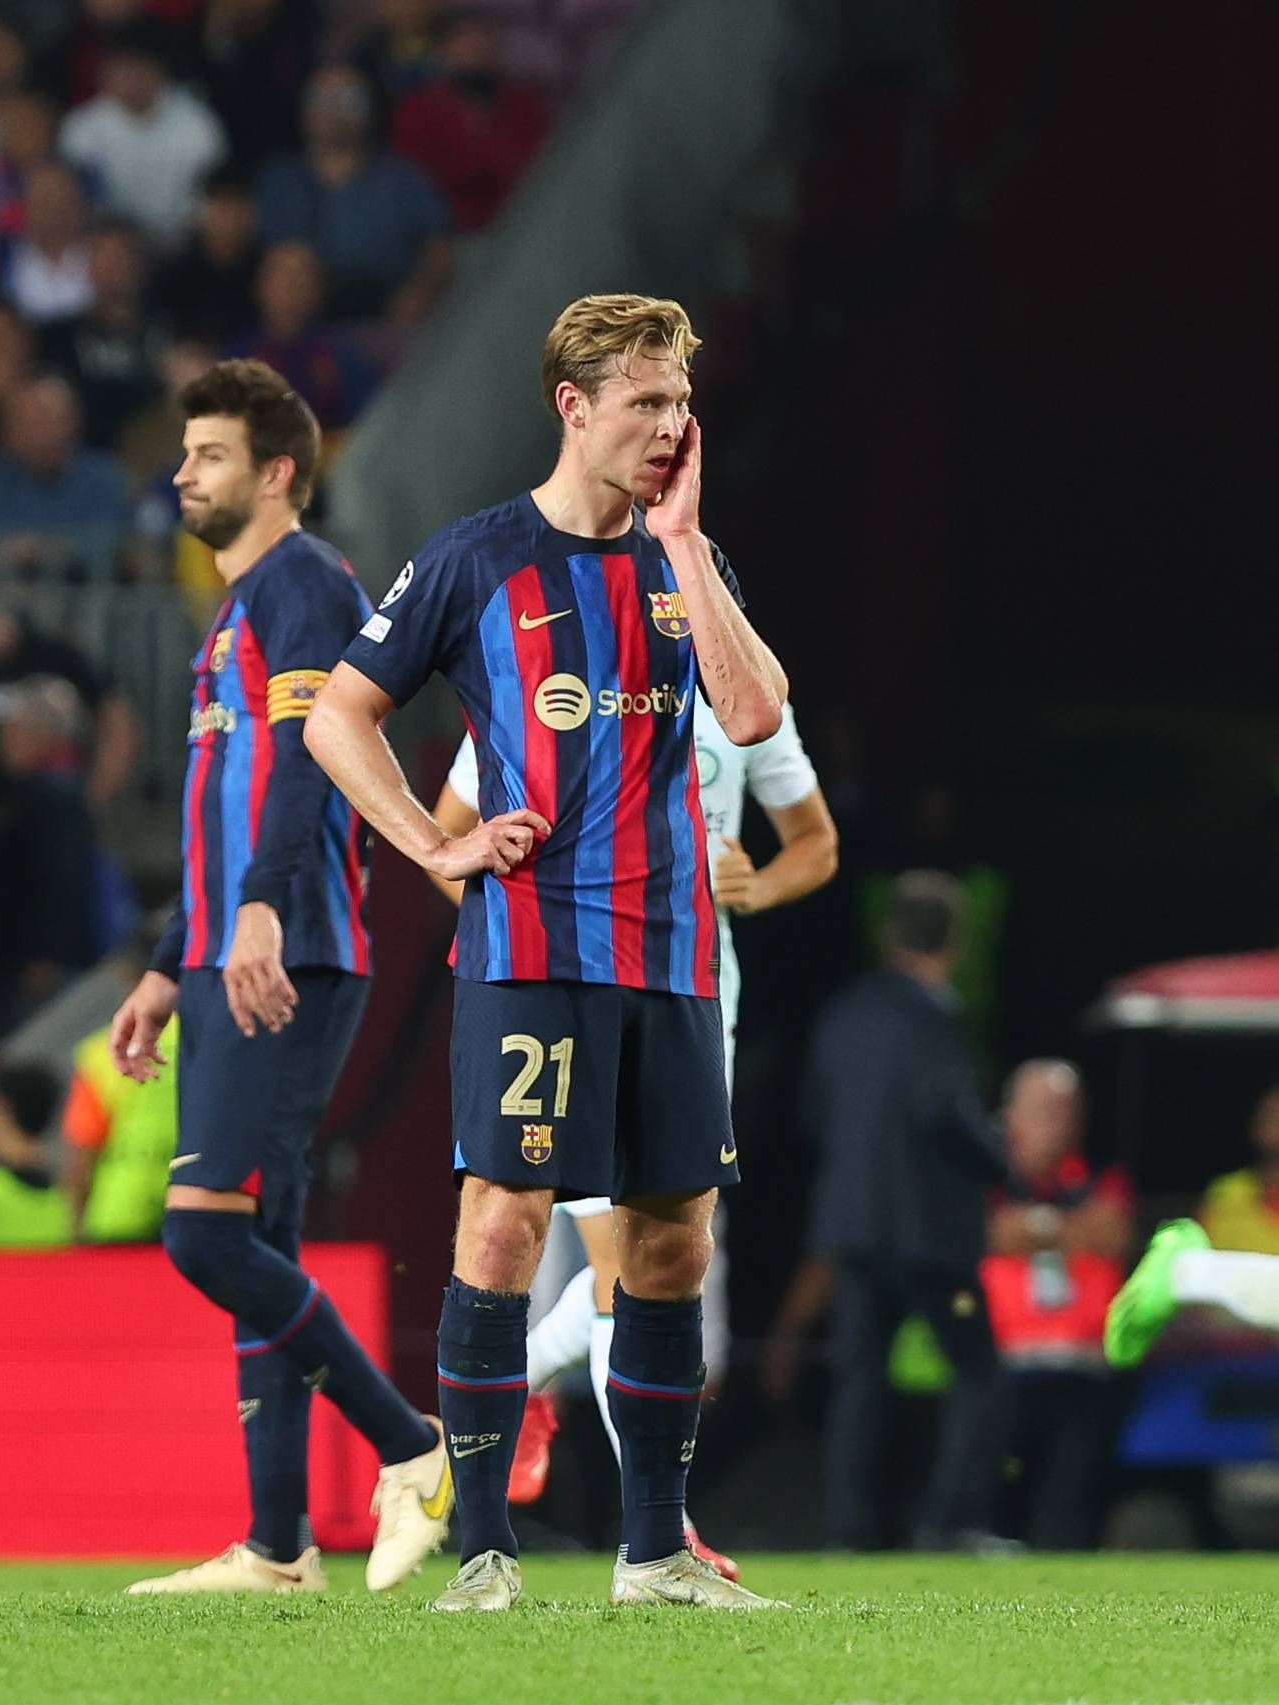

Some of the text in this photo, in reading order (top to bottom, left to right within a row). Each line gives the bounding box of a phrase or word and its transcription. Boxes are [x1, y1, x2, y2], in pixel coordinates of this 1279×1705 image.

[596, 683, 689, 720] Spotify
[500, 1033, 574, 1118] 21
[450, 1433, 501, 1445] barça
